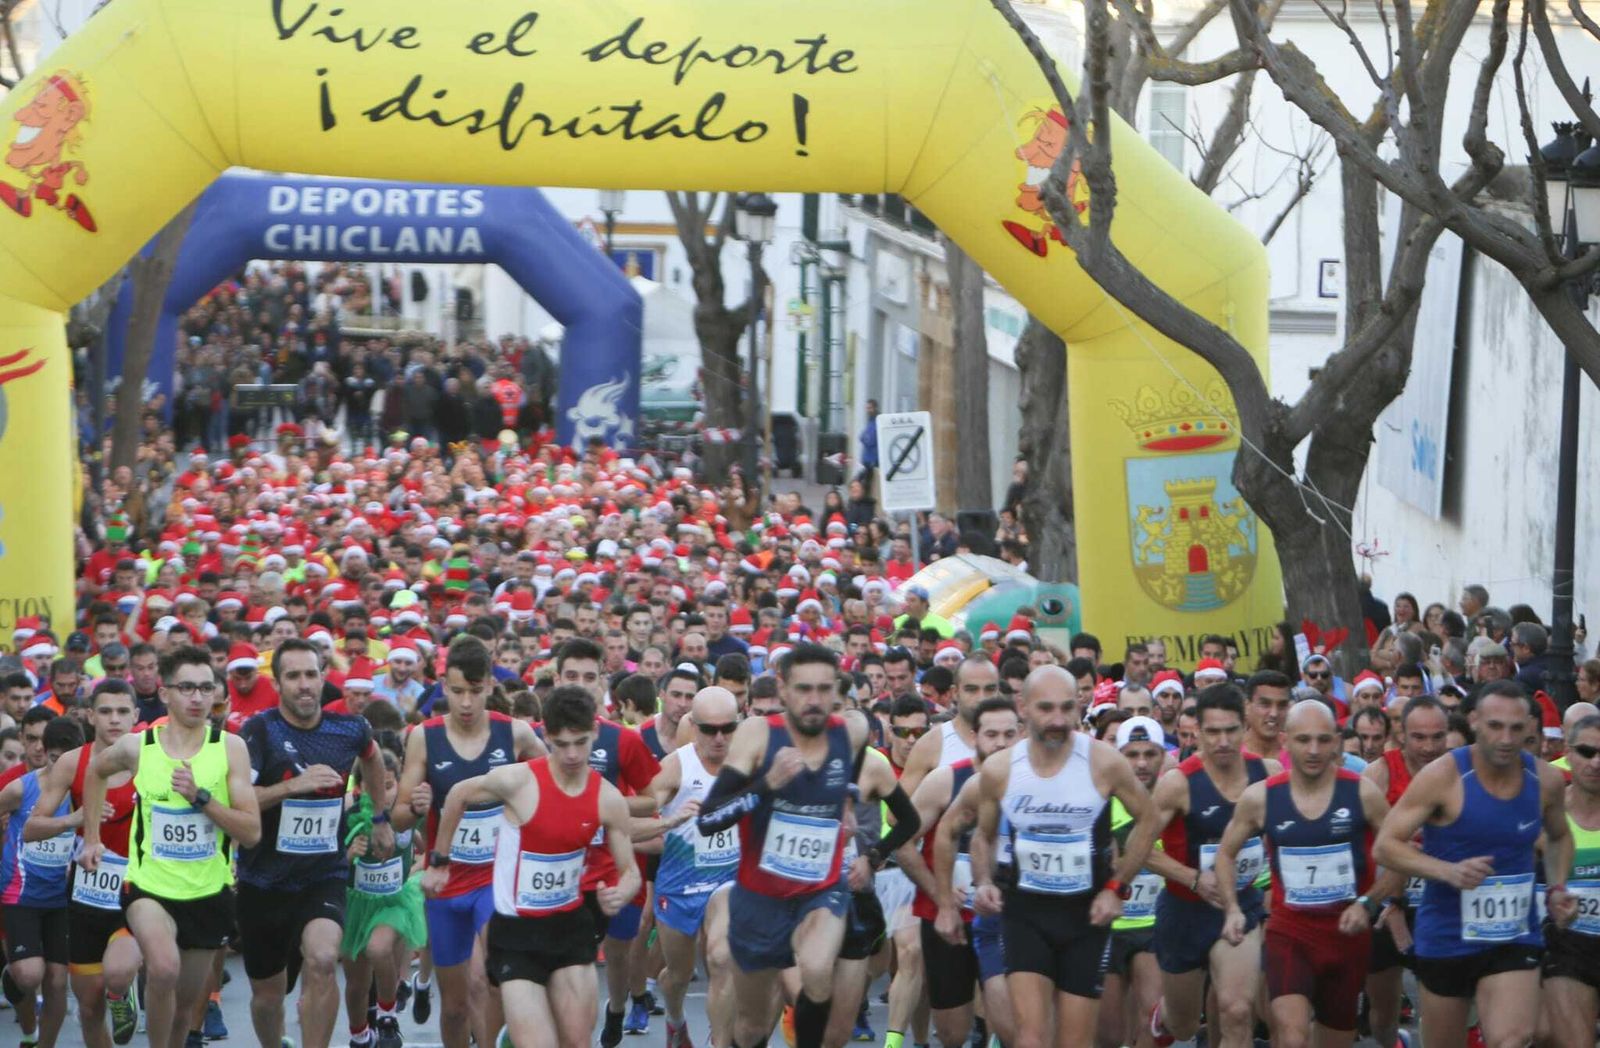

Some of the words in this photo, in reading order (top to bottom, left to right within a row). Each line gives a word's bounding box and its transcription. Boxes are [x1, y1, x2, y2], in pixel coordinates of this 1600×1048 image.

[272, 0, 421, 52] Vive
[466, 12, 539, 57] el
[581, 17, 859, 86] deporte
[268, 186, 485, 217] DEPORTES
[263, 223, 485, 255] CHICLANA
[1014, 795, 1093, 814] Pedales
[163, 824, 198, 842] 695
[293, 817, 323, 835] 701
[459, 827, 481, 845] 74
[708, 830, 733, 849] 781
[775, 833, 823, 860] 1169
[1029, 853, 1065, 873] 971
[82, 870, 120, 891] 1100
[363, 872, 389, 882] 1076
[532, 870, 566, 890] 694
[1306, 866, 1319, 885] 7
[1472, 896, 1518, 919] 1011
